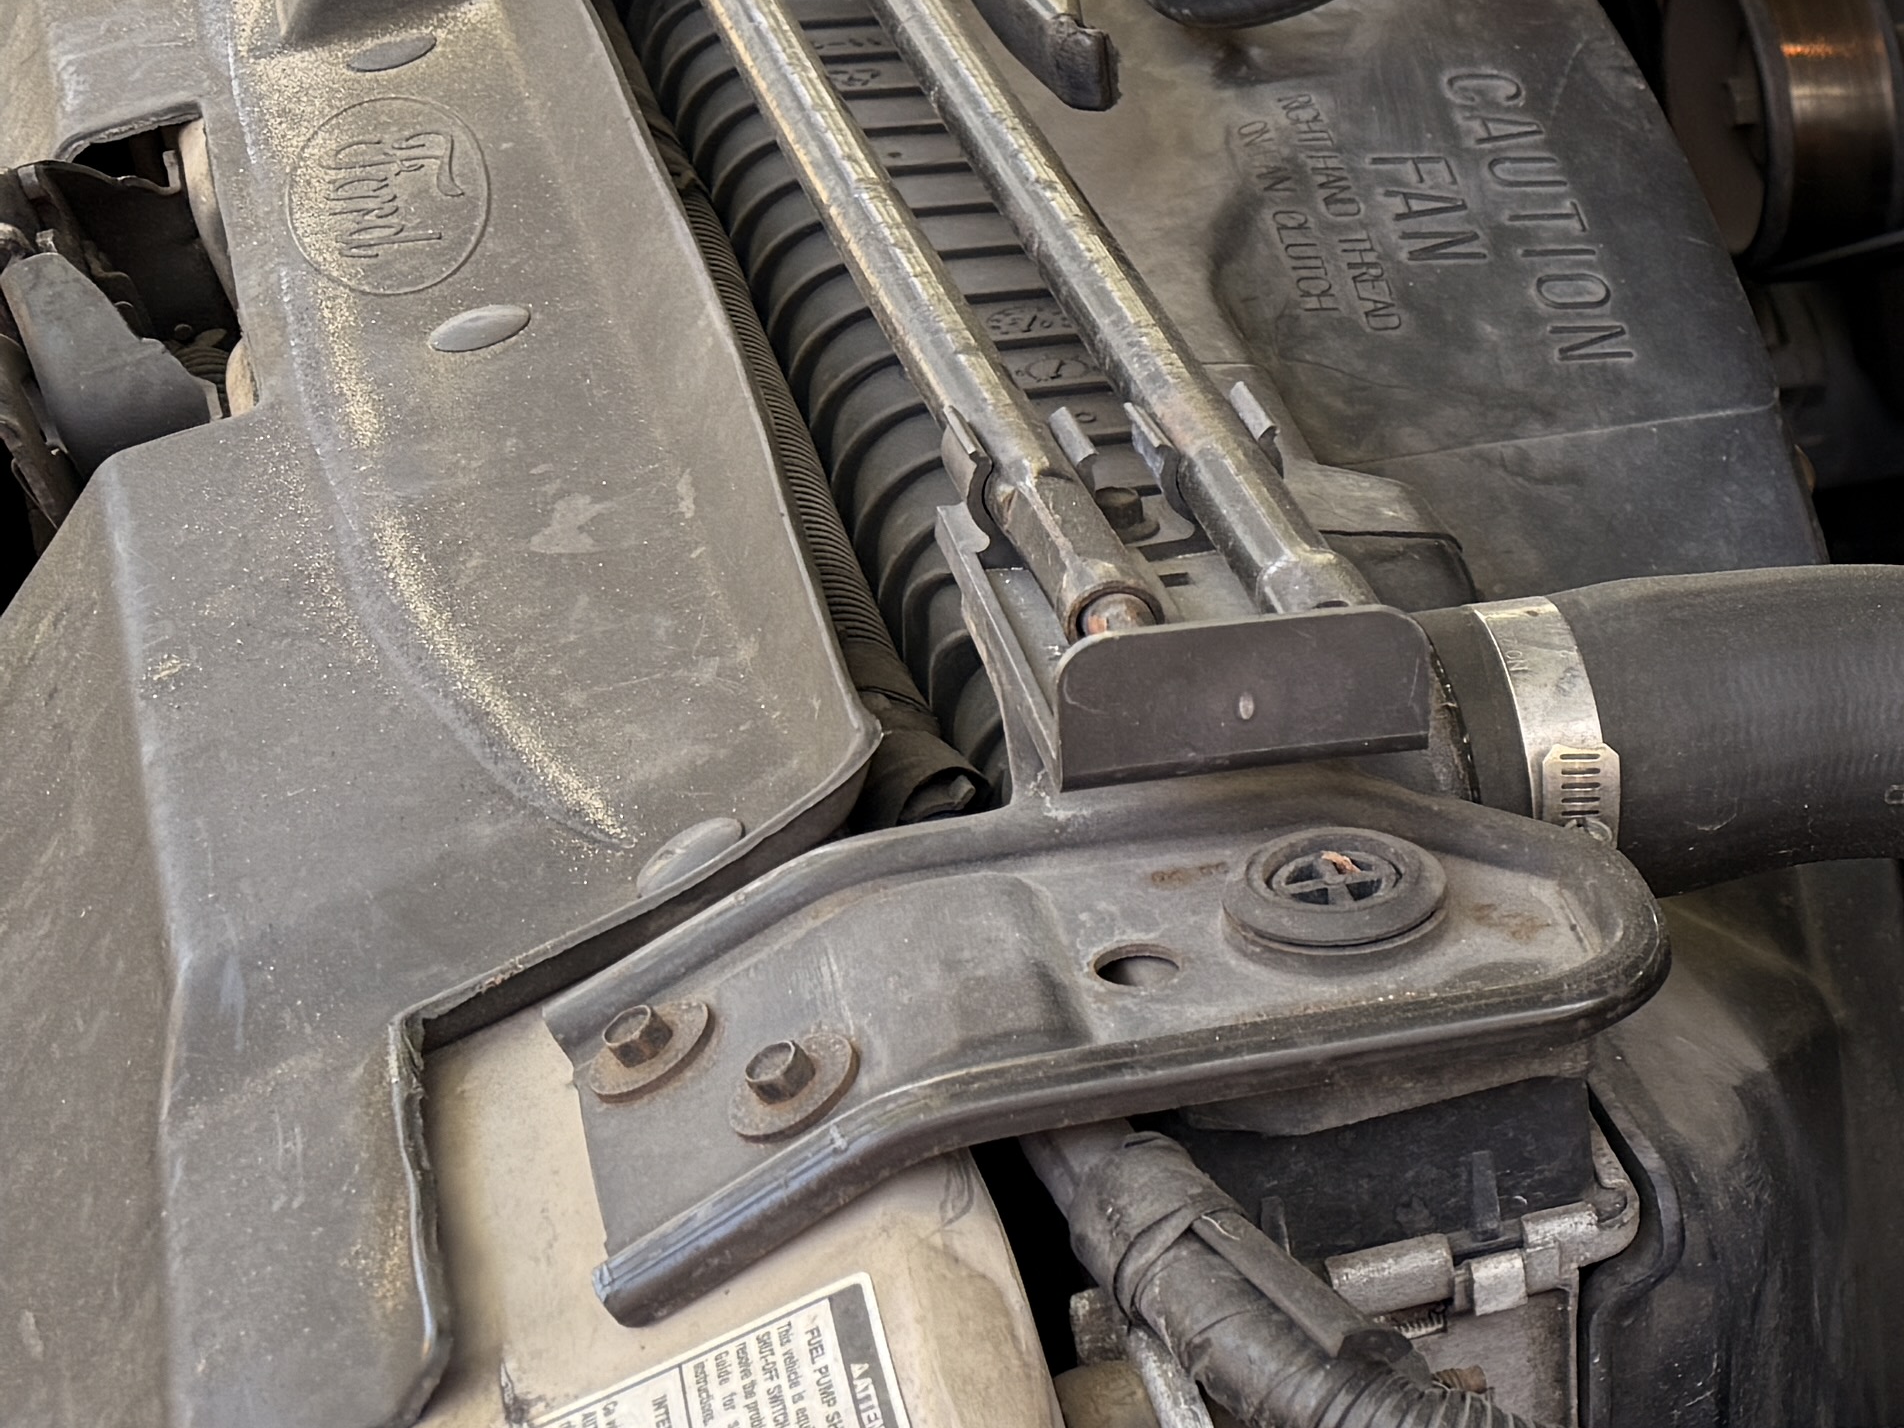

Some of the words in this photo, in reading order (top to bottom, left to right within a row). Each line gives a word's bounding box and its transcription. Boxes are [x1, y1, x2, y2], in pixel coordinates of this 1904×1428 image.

[329, 131, 467, 261] Ford
[1307, 154, 1361, 217] HAND
[1339, 232, 1402, 331] THREAD
[1369, 153, 1488, 267] FAN
[1445, 71, 1636, 366] CAUTION
[1272, 210, 1340, 312] CLUTCH
[802, 1325, 827, 1364] FUEL
[812, 1364, 838, 1409] PUMP
